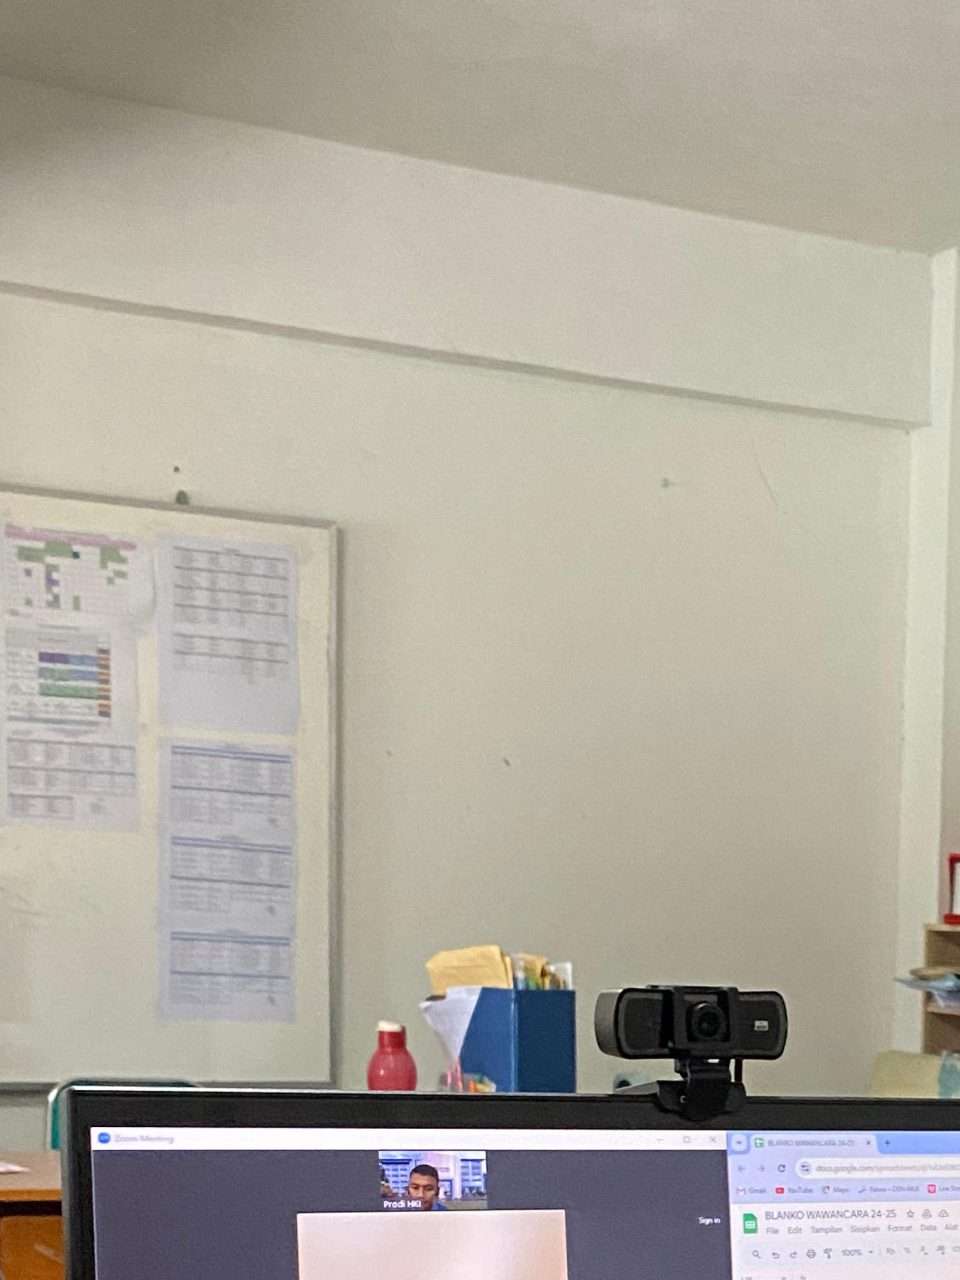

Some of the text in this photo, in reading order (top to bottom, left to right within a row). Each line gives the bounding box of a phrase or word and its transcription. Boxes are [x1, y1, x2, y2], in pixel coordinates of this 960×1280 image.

[383, 1200, 406, 1209] Prodi
[764, 1210, 804, 1221] BLANKO
[806, 1209, 870, 1220] WAWANCARA
